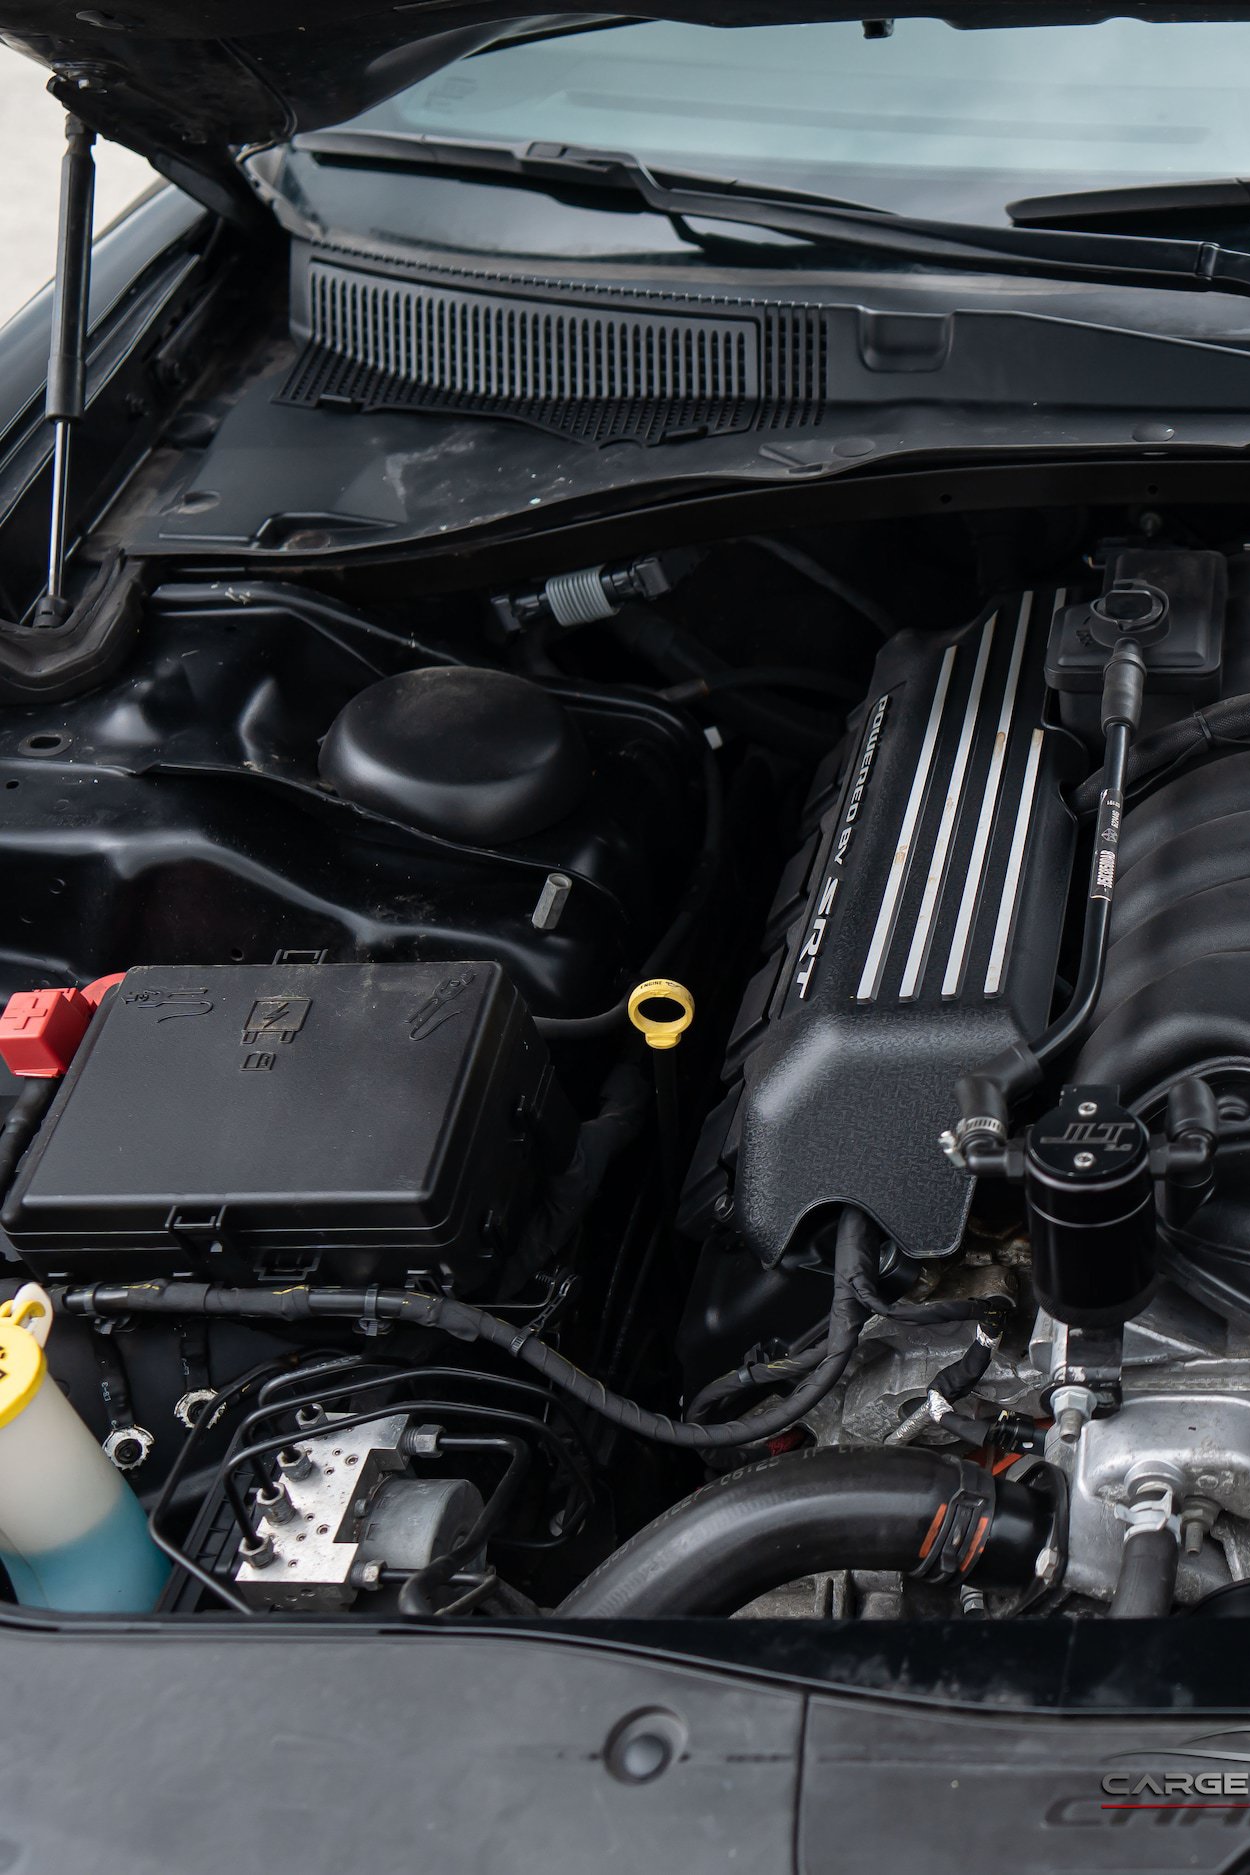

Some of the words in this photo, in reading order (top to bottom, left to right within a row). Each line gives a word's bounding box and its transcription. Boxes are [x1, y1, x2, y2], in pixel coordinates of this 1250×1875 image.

[846, 694, 889, 823] POWERED
[834, 827, 852, 865] BY
[796, 877, 839, 999] SRT
